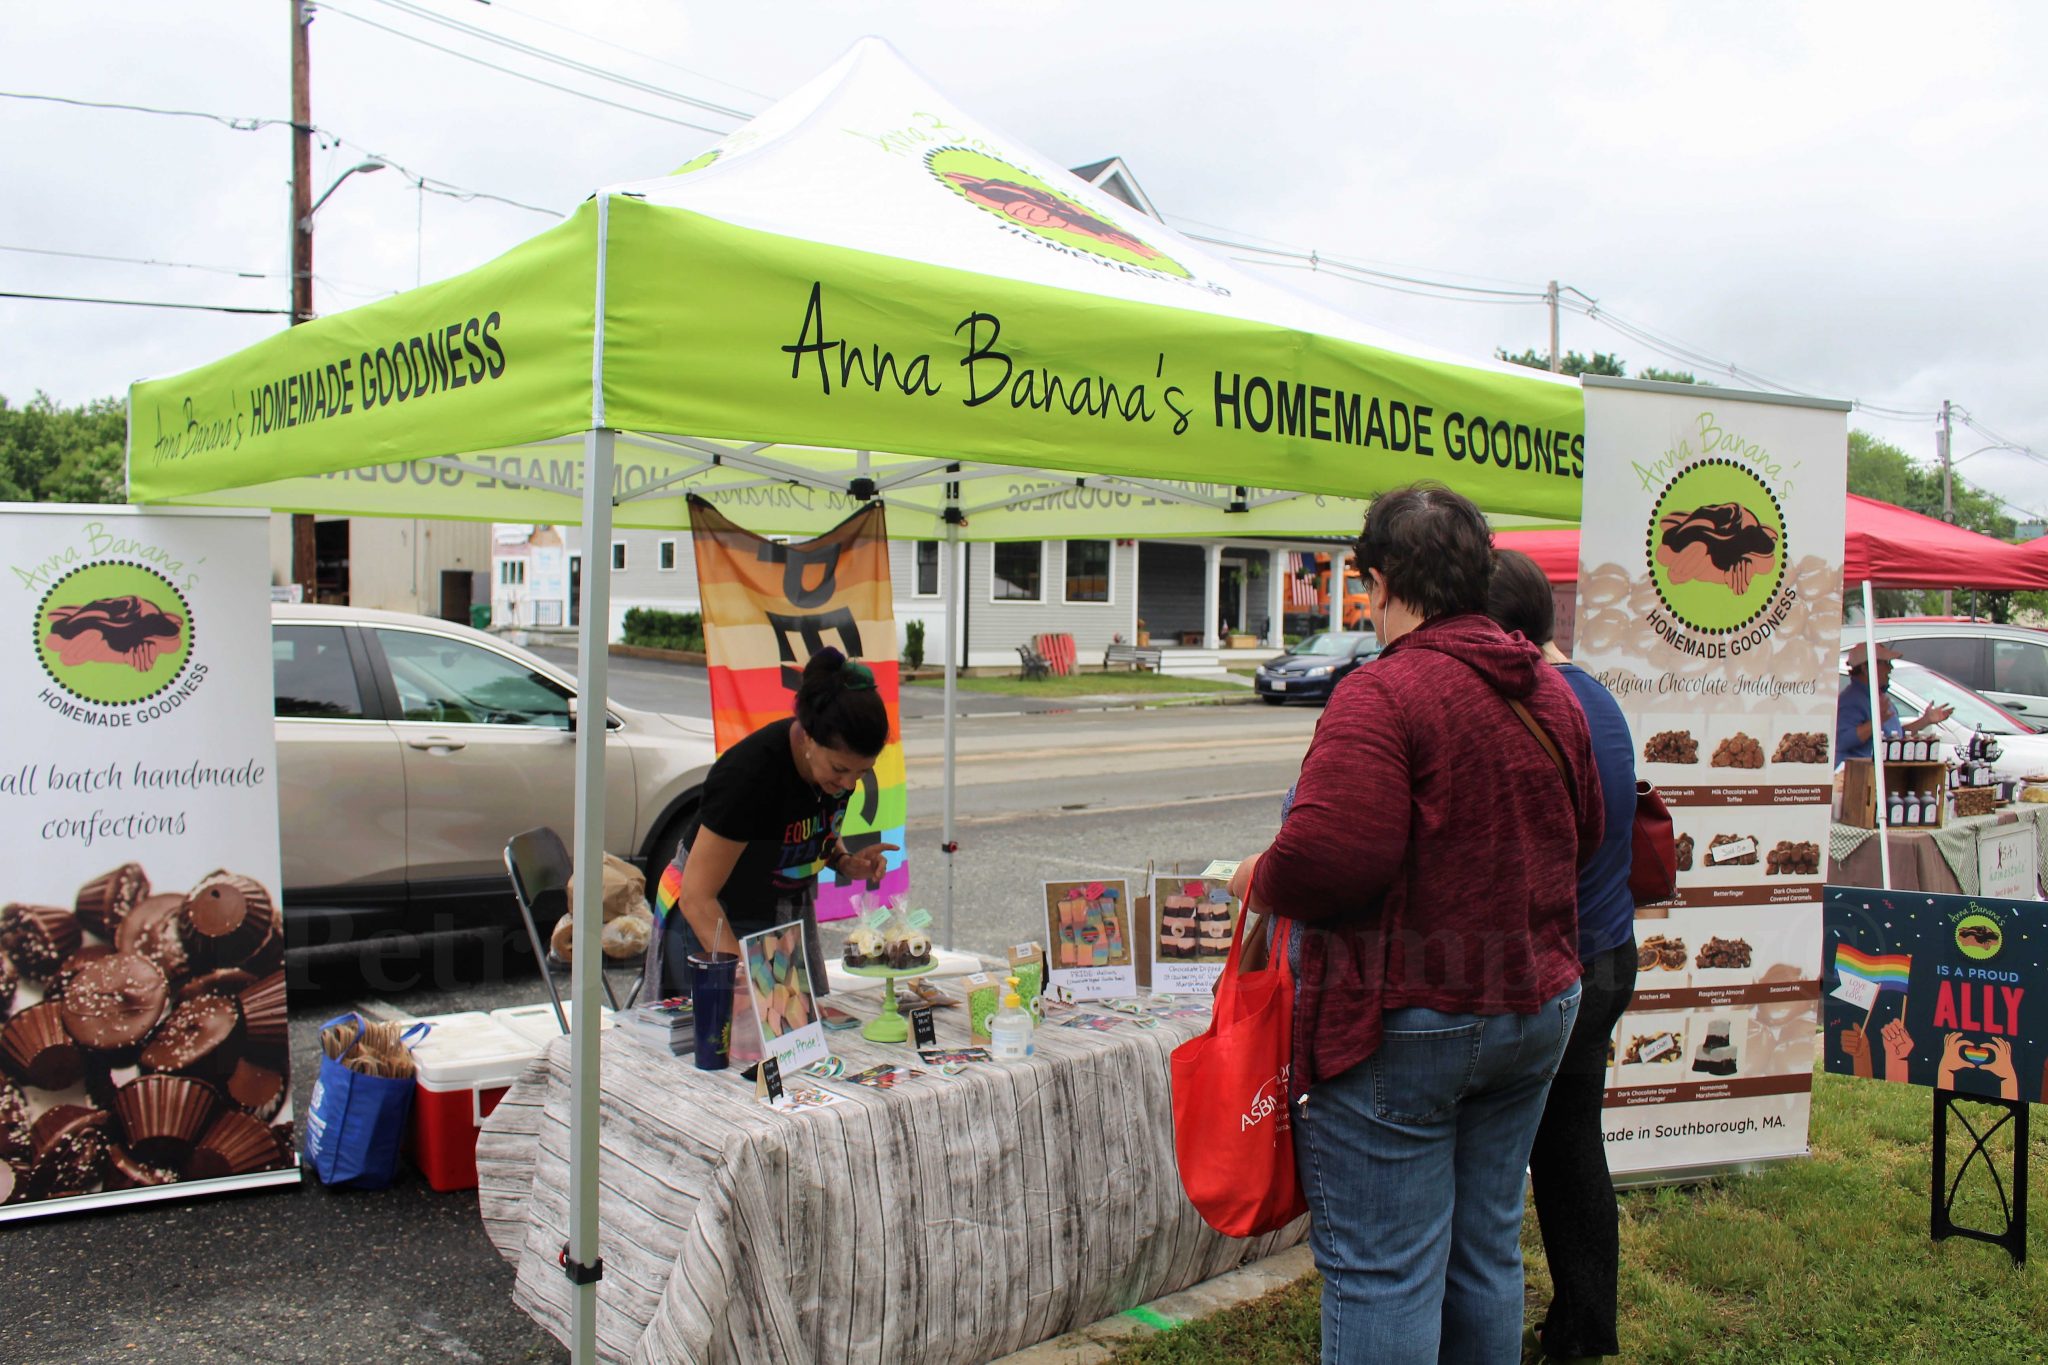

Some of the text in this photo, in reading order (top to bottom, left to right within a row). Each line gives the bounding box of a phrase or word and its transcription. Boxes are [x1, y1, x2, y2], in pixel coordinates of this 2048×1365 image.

[153, 311, 506, 468] Anna Banana's HOMEMADE GOODNESS
[781, 281, 1585, 479] Anna Banana's HOMEMADE GOODNES
[1631, 412, 1801, 499] Anna Banana's
[9, 522, 206, 592] Anna Banana's
[1646, 587, 1797, 659] HOMEMADE GOODNESS
[37, 662, 209, 727] HOMEMADE GOODNESS
[1594, 671, 1817, 700] Belgian Chocolate Indulgences
[48, 762, 122, 793] batch
[133, 758, 265, 790] handmade
[1660, 797, 1677, 805] offee
[1747, 788, 1759, 796] with
[1773, 795, 1821, 804] Crushed Peppermint
[41, 809, 187, 847] confections
[1674, 899, 1687, 907] Cups
[1790, 894, 1813, 902] Caramels
[1948, 908, 1968, 922] Anna
[1937, 965, 2019, 983] IS A PROUD
[1639, 992, 1671, 1001] Kitchen Sink
[1698, 988, 1745, 998] Raspberry Almond
[1932, 980, 2025, 1036] ALLY
[1617, 1090, 1630, 1098] Dark
[1631, 1089, 1657, 1097] Chocolate
[1658, 1088, 1677, 1096] Dipped
[1649, 1096, 1666, 1104] Ginger
[1638, 1127, 1651, 1140] in
[1655, 1117, 1758, 1138] Southborough,
[1762, 1116, 1786, 1128] MA.
